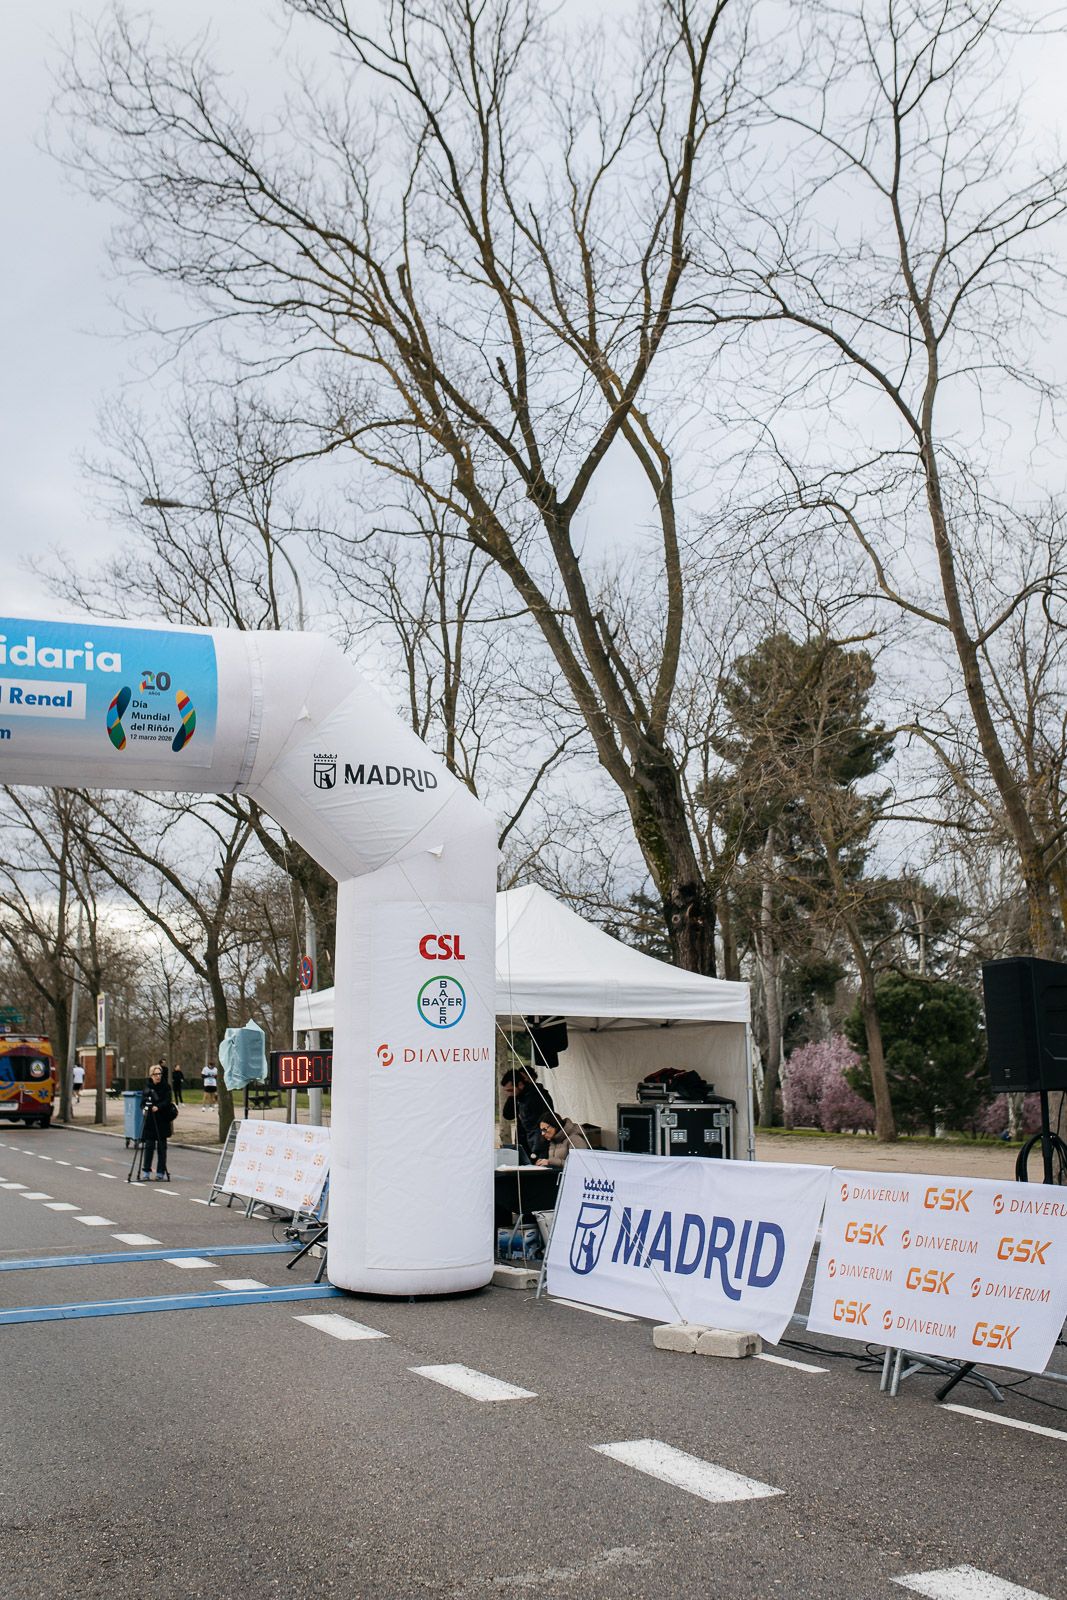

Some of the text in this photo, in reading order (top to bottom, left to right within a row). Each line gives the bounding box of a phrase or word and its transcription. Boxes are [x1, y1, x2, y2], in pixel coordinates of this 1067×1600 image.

[140, 670, 171, 692] 20
[9, 687, 73, 708] Renal
[132, 699, 148, 709] Día
[130, 722, 175, 733] del Riñón
[131, 711, 170, 722] Mundial
[344, 763, 438, 792] MADRID
[418, 934, 466, 960] CSL
[422, 997, 463, 1007] BAYER
[404, 1047, 490, 1063] DIAVERUM
[852, 1187, 910, 1203] DIAVERUM
[923, 1186, 974, 1213] GSK
[611, 1206, 786, 1301] MADRID
[844, 1221, 1053, 1265] GSK DIAVERUM GSK
[839, 1263, 1051, 1304] DIAVERUM GSK DIAVERUM
[833, 1299, 1021, 1350] GSK DIAVERUM GSK
